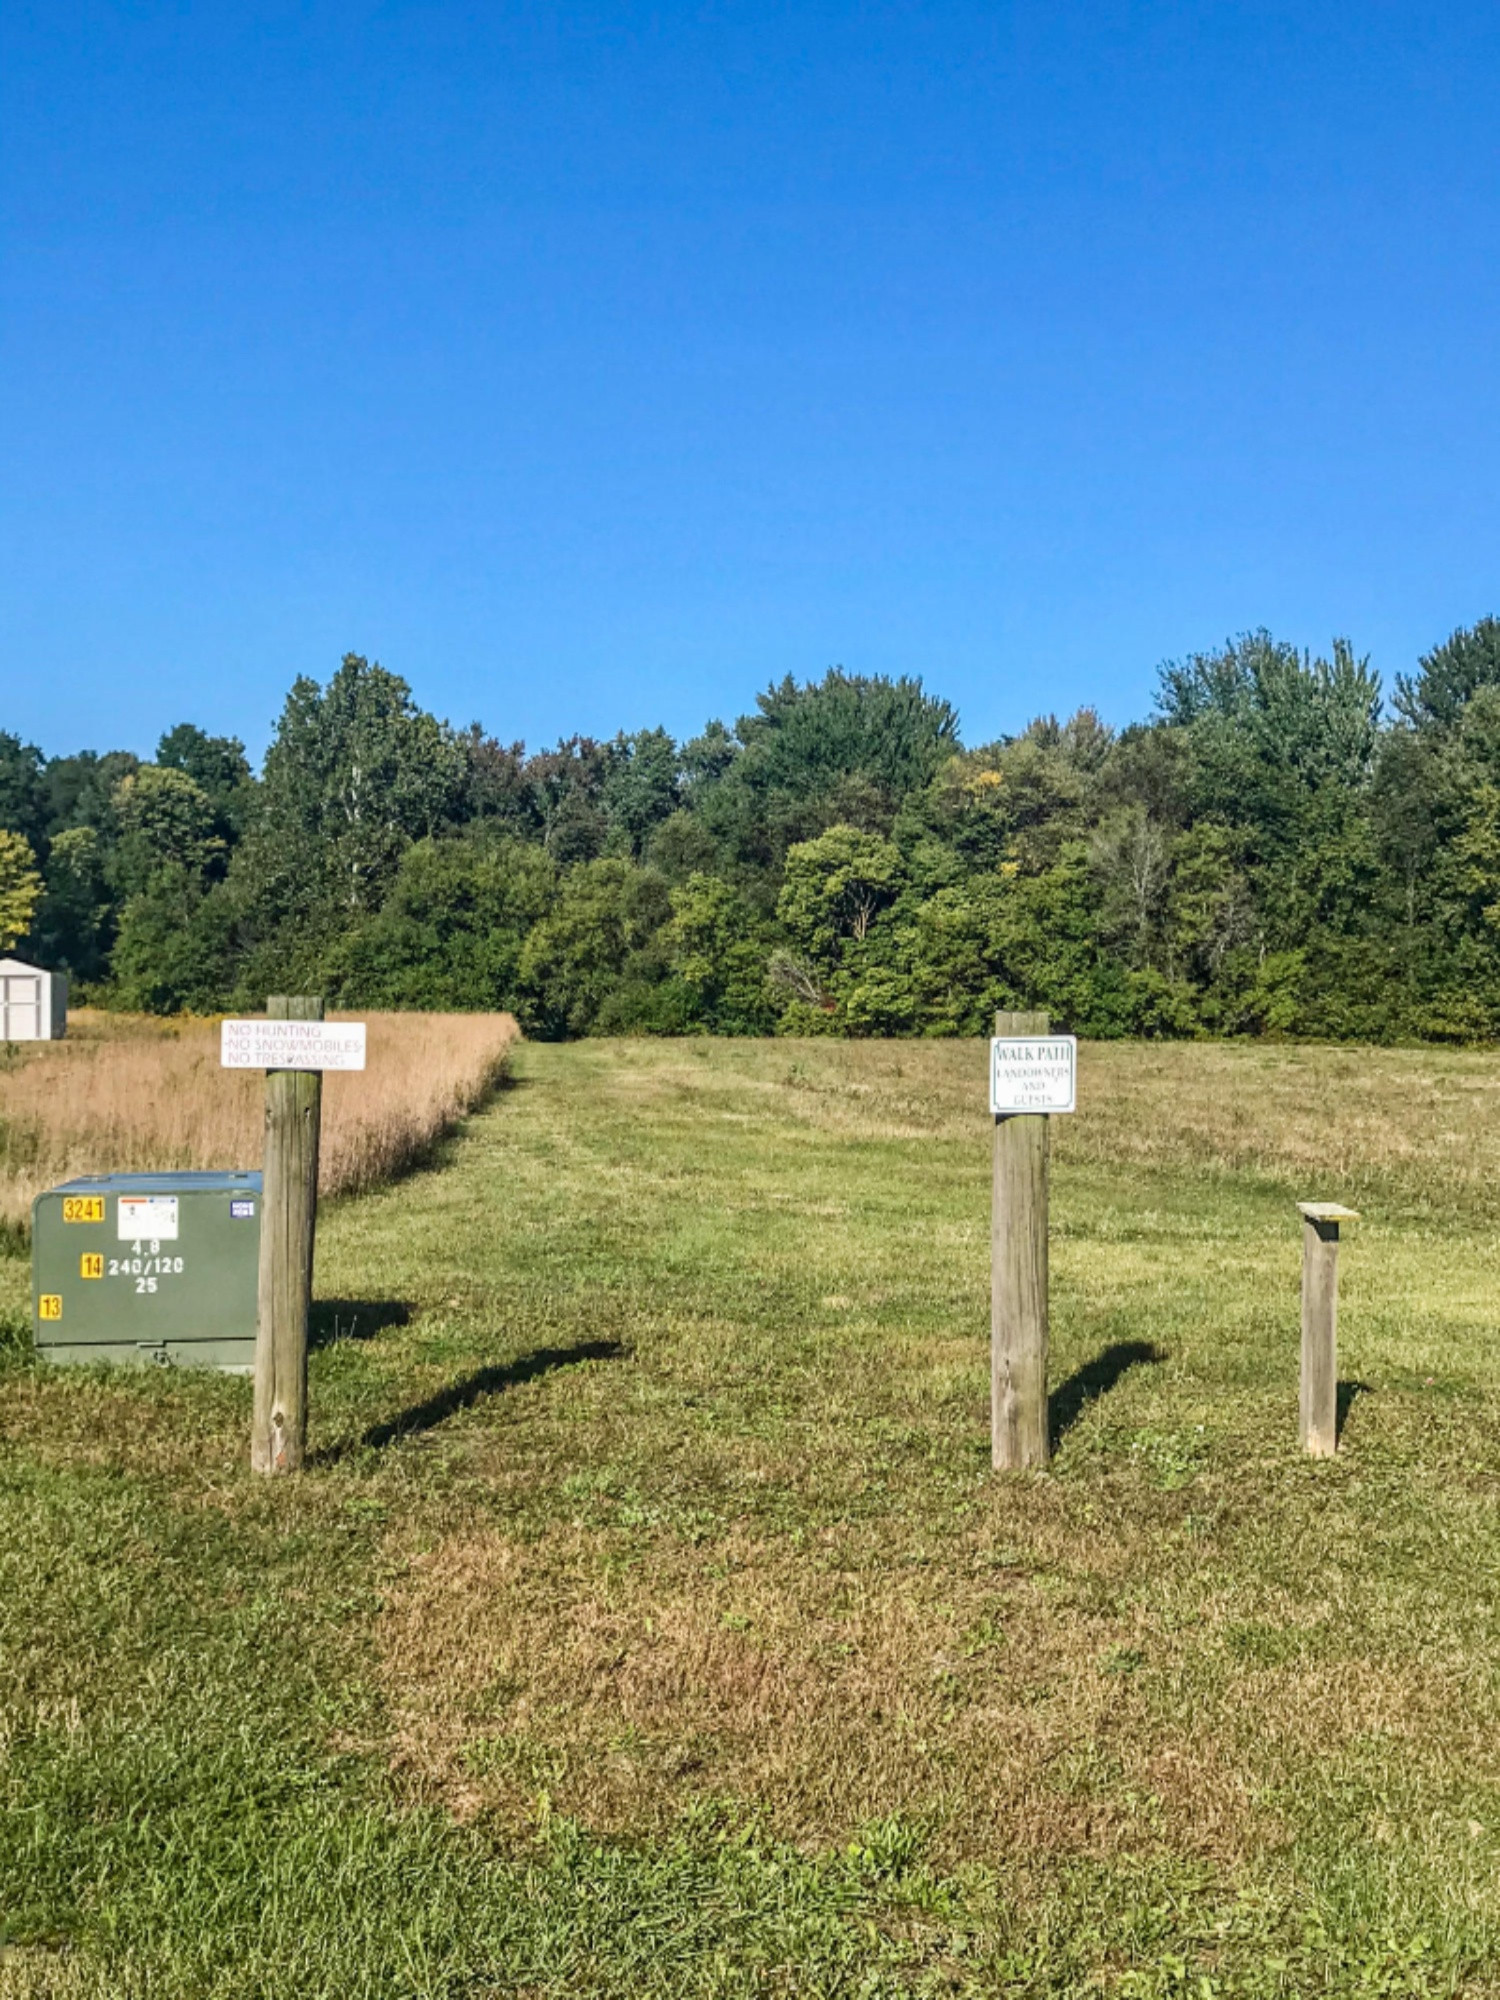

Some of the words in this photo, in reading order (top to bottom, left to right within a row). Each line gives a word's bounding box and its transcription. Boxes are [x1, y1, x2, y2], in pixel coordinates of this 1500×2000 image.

[229, 1024, 251, 1036] NO
[256, 1025, 322, 1037] HUNTING
[229, 1038, 250, 1050] NO
[255, 1039, 360, 1053] SNOWMOBILES
[229, 1052, 250, 1064] NO
[997, 1047, 1034, 1061] WALK
[1037, 1047, 1070, 1060] PATH
[1022, 1082, 1046, 1091] AND
[65, 1199, 104, 1220] 3241
[85, 1255, 102, 1276] 14
[108, 1257, 184, 1276] 240/120
[135, 1277, 158, 1293] 25
[44, 1297, 61, 1318] 13
